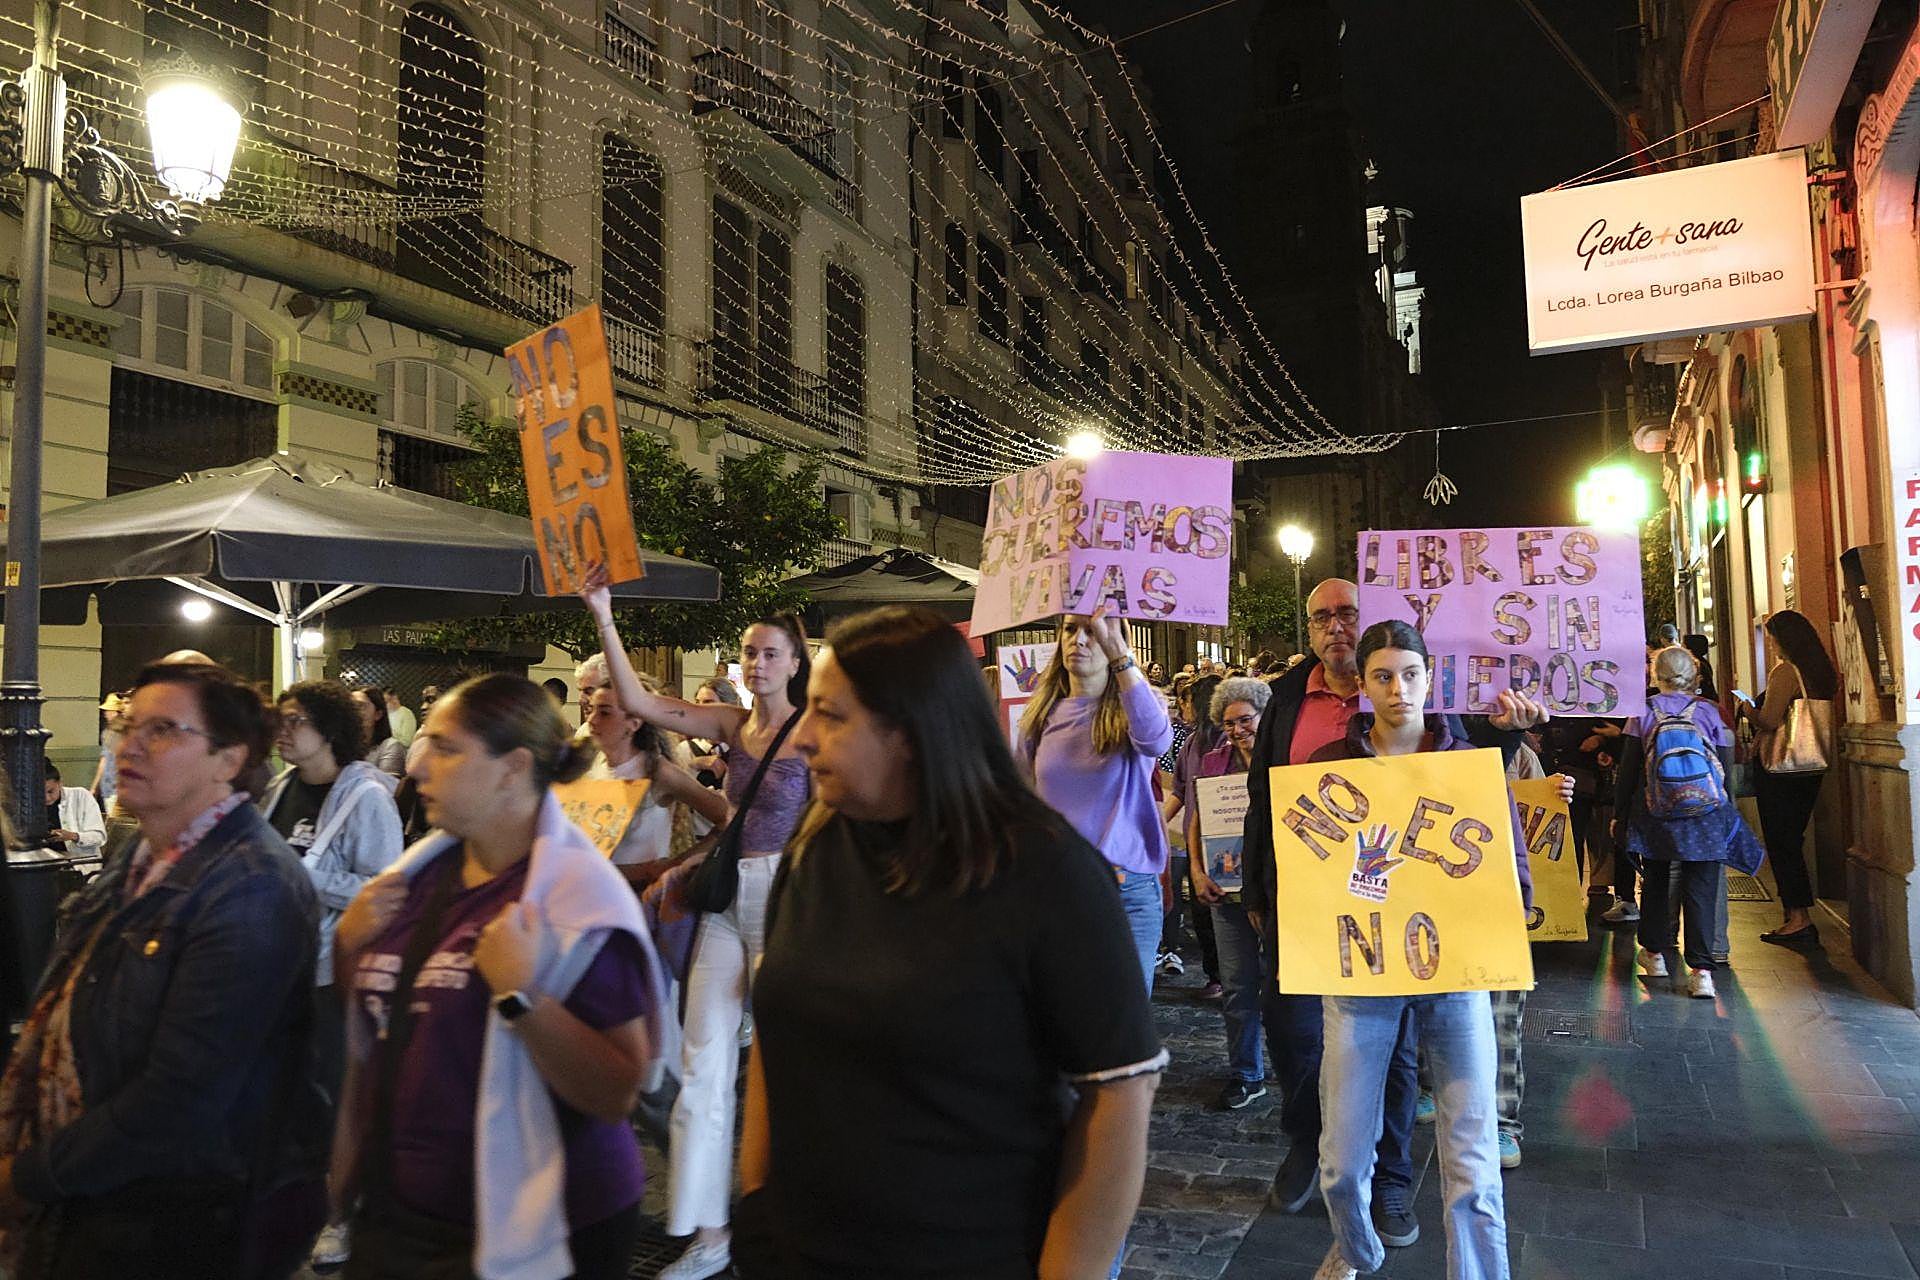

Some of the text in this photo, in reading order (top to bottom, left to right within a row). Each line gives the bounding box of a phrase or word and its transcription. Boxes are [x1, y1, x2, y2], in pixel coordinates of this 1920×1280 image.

[1548, 269, 1785, 312] Lcda. Lorea Burgaña Bilbao
[507, 326, 579, 432] NO
[541, 404, 612, 507] ES
[993, 459, 1088, 528] NOS
[541, 502, 610, 592] NO
[981, 499, 1233, 576] QUEREMOS
[1364, 530, 1600, 590] LIBRES
[1010, 562, 1178, 623] VIVAS
[1403, 593, 1442, 635] Y
[1490, 590, 1600, 651] SIN
[383, 629, 401, 644] LAS
[1424, 652, 1621, 714] IEDOS
[1281, 772, 1494, 879] NO ES
[1352, 872, 1388, 888] BASTA
[1336, 912, 1440, 980] NO
